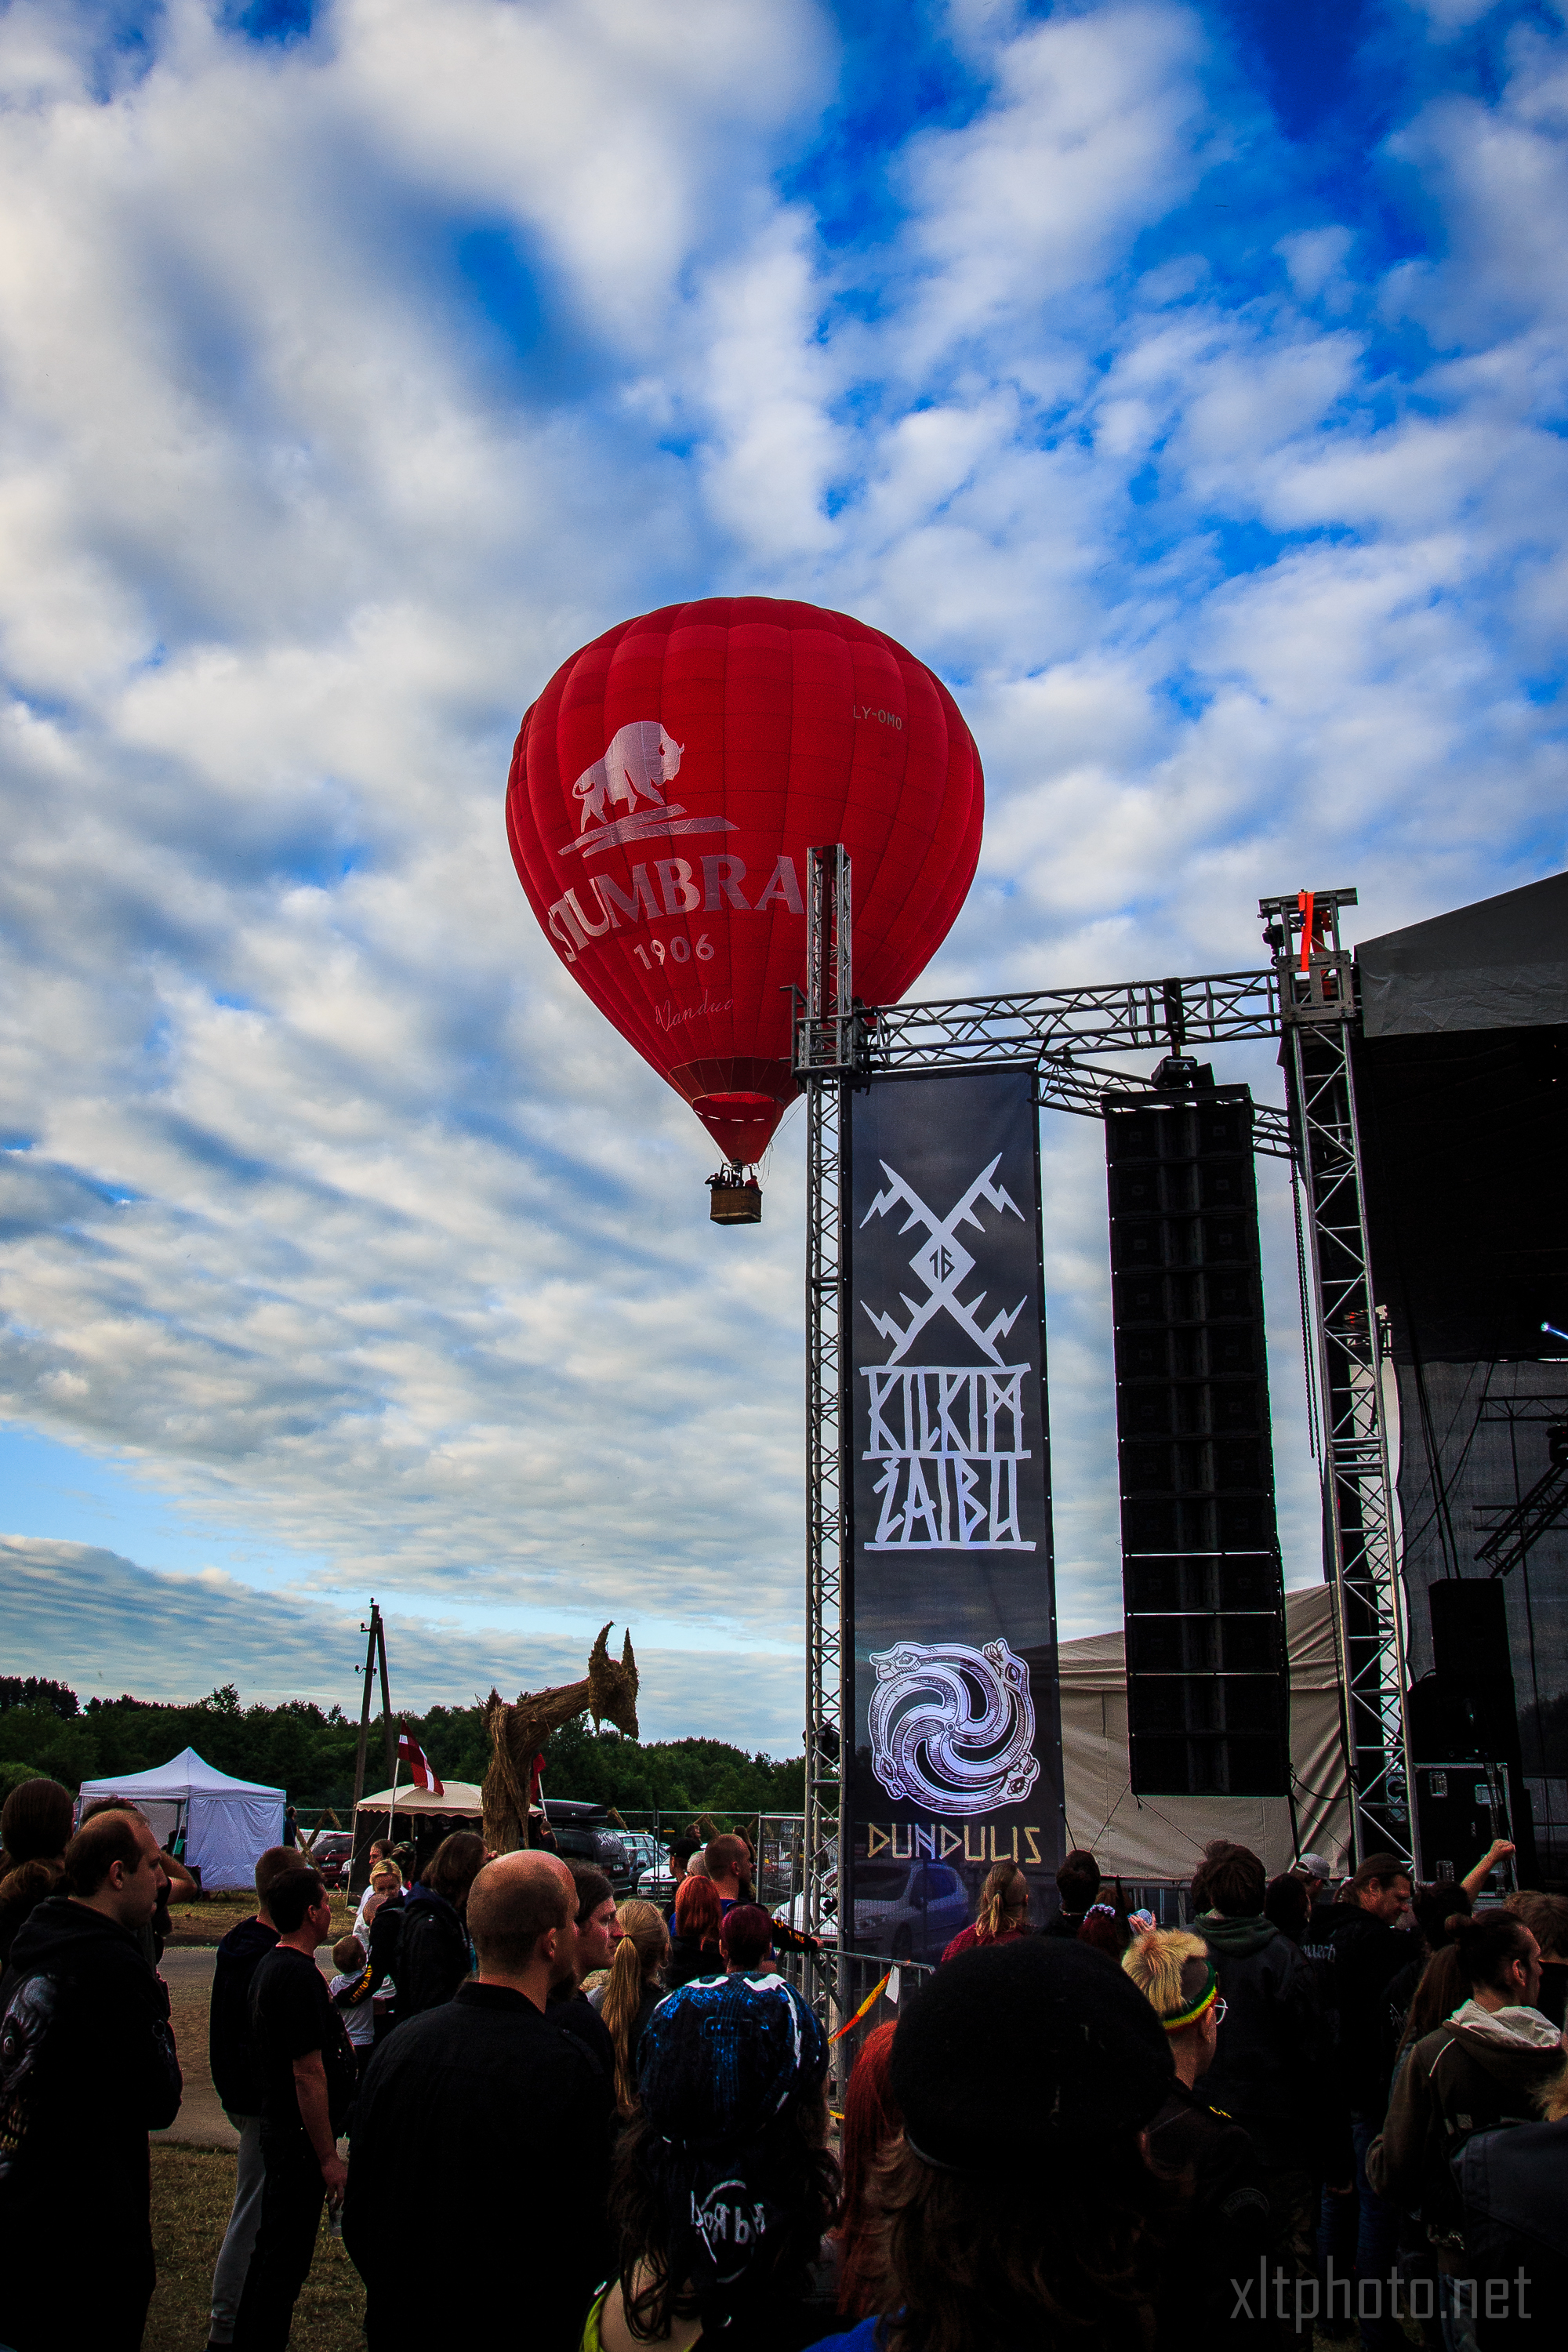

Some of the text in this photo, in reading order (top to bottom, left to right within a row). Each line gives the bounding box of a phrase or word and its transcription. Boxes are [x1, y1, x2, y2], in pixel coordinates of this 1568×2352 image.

[548, 854, 836, 963] STUMBRA
[633, 934, 714, 970] 1906
[928, 1243, 956, 1283] 16
[867, 1822, 1041, 1864] DUNDULIS
